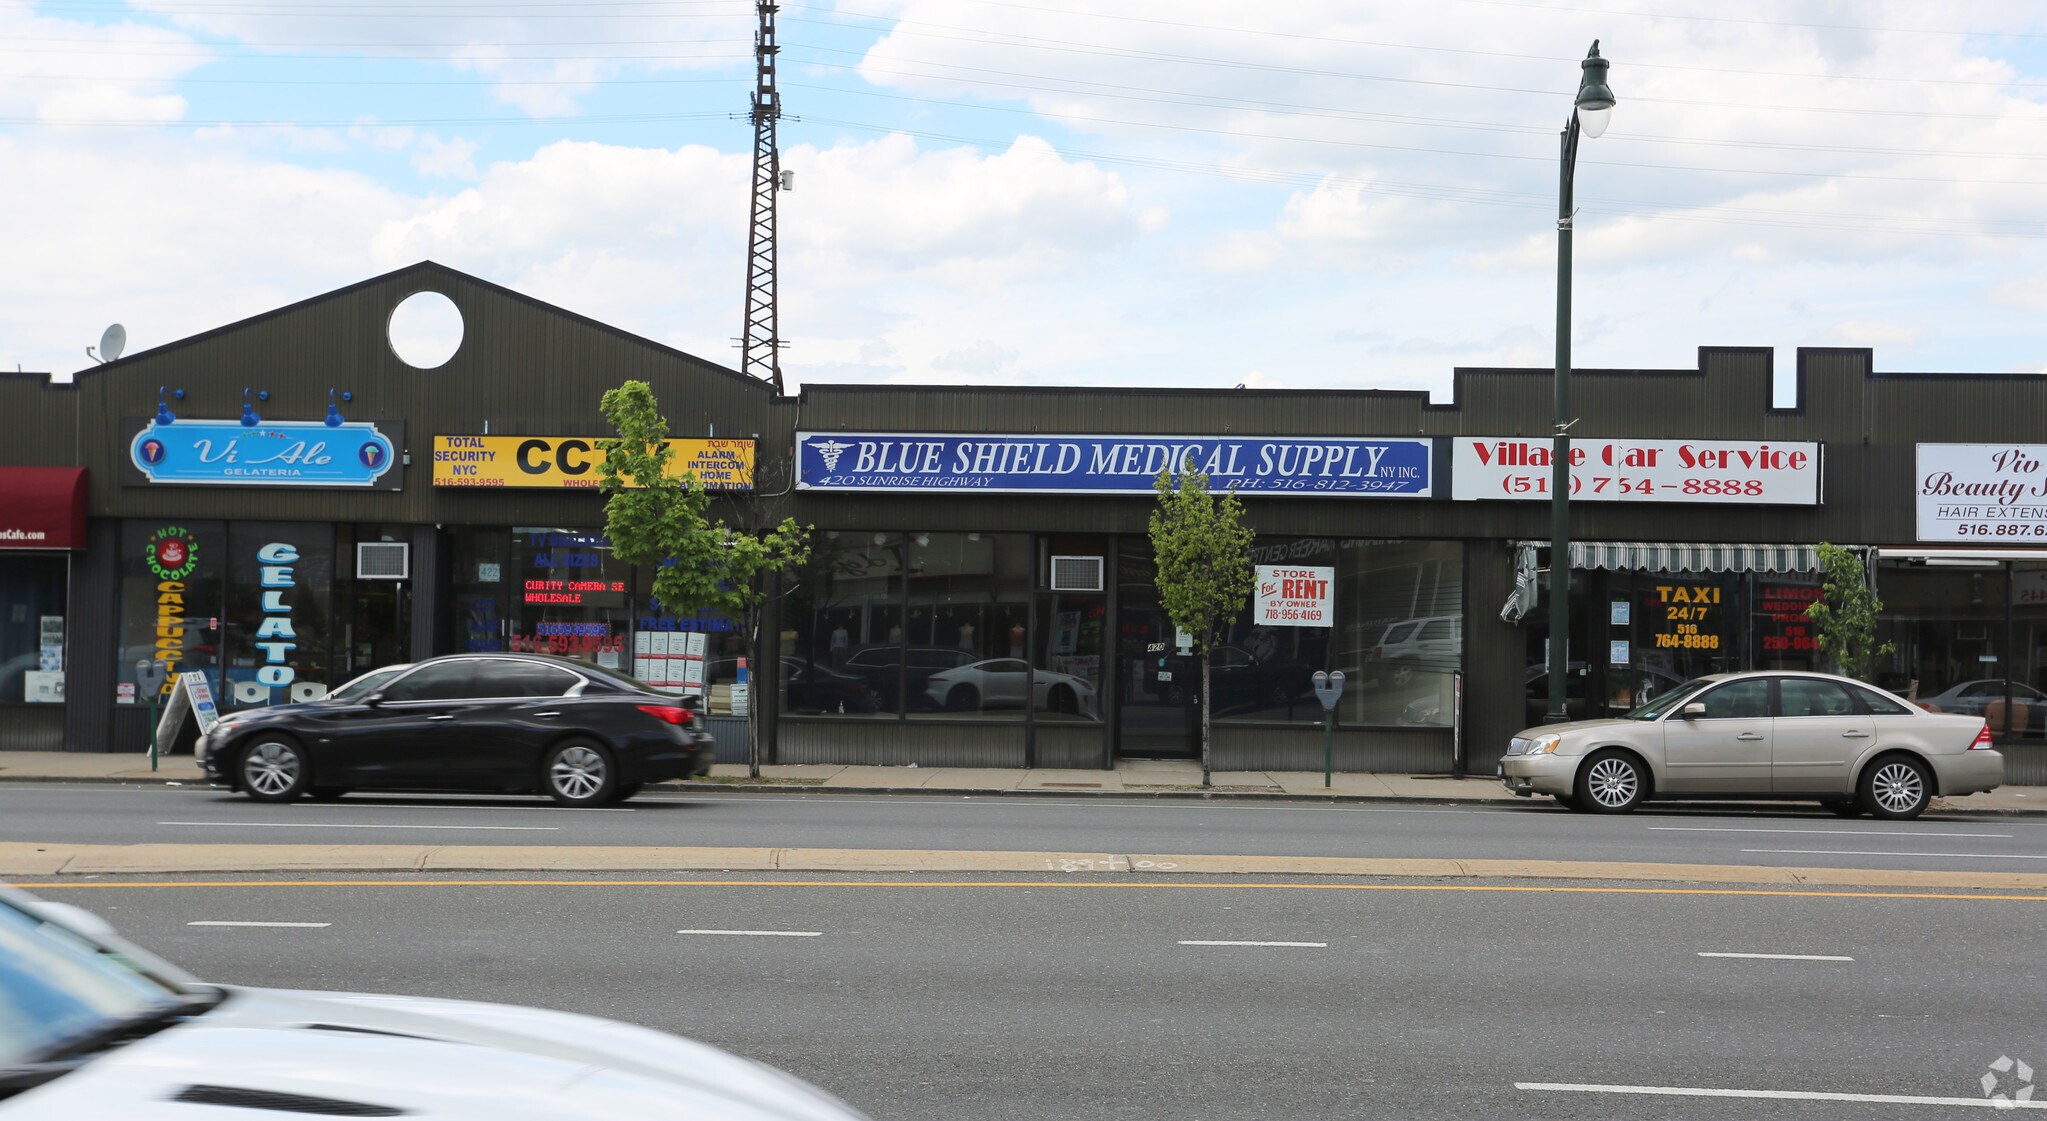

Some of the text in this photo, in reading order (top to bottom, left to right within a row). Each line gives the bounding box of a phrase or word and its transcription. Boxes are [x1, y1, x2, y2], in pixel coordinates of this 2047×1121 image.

[446, 437, 484, 447] TOTAL
[193, 439, 332, 465] Vi Ale
[435, 451, 496, 461] SECURITY
[698, 450, 735, 459] ALARM
[1601, 444, 1663, 467] Car
[1678, 445, 1807, 471] Service
[688, 461, 745, 470] INTERCOM
[852, 441, 1420, 478] BLUE SHIELD MEDICAL SUPPLY NY INC.
[223, 468, 301, 476] GELATERIA
[453, 465, 477, 475] NYC
[700, 471, 732, 480] HOME
[435, 478, 504, 486] 516-593-9595
[680, 481, 752, 490] AOMATION
[819, 475, 994, 487] 420 SUNRISE HIGHWAY
[1225, 478, 1410, 491] PH: 516-812-3947
[1502, 474, 1582, 495] (51)
[1922, 471, 2028, 505] Beauty
[1938, 506, 2047, 518] HAIR EXTEN
[157, 525, 187, 538] HOT
[1957, 524, 2047, 536] 516.887.6
[145, 543, 199, 581] CHOCOLATE
[534, 552, 559, 567] ALL
[481, 567, 498, 577] 422
[1272, 569, 1316, 578] STORE
[525, 580, 625, 592] CURITY CAMERA SE
[1261, 579, 1329, 599] For RENT
[525, 593, 581, 603] WHOLESALE
[1656, 586, 1720, 604] TAXI
[1762, 601, 1811, 611] WEDDIN
[254, 542, 300, 688] GELATO
[1265, 609, 1322, 620] 718-956-4169
[1667, 606, 1708, 620] 24/7
[537, 624, 607, 636] 5165939595
[639, 617, 676, 631] FREE
[1677, 624, 1698, 635] 516
[1655, 633, 1719, 650] 764-8888
